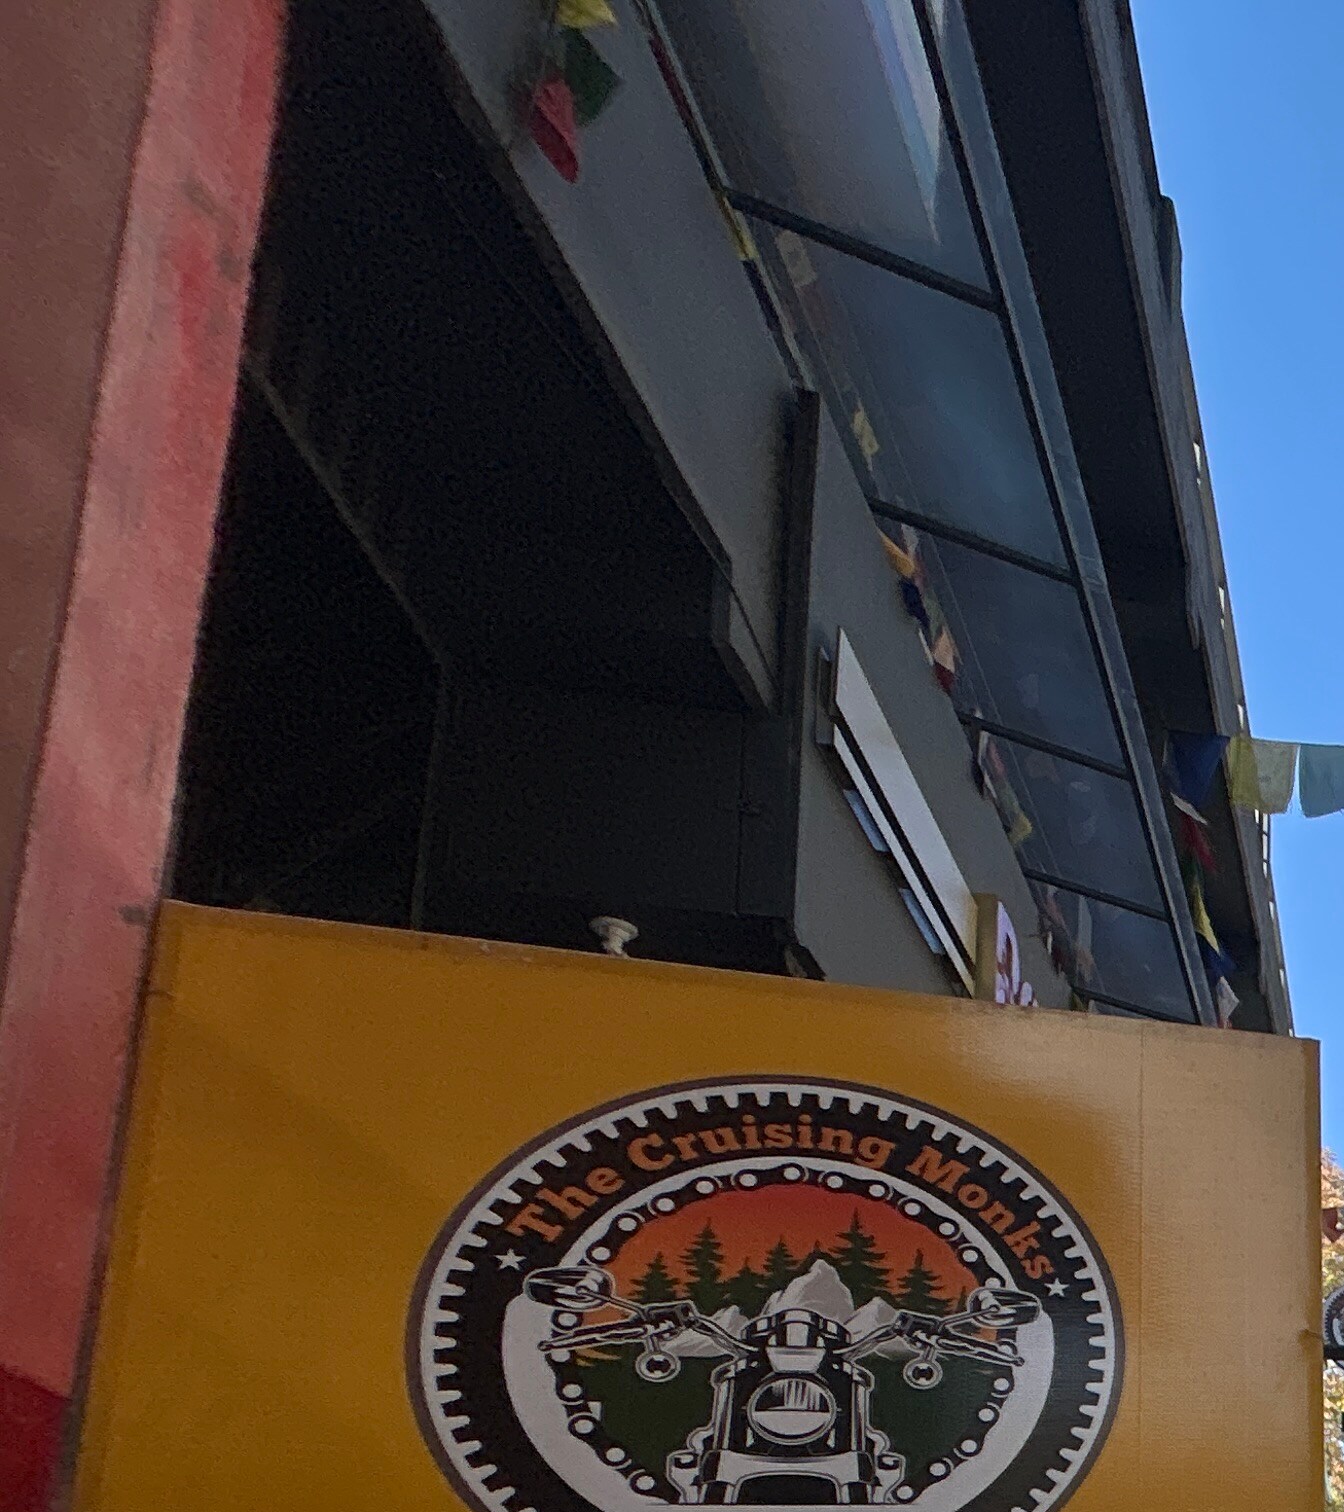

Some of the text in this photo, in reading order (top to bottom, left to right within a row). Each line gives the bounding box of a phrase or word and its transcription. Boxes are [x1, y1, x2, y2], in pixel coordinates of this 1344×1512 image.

[505, 1113, 1056, 1281] The Cruising Monks
